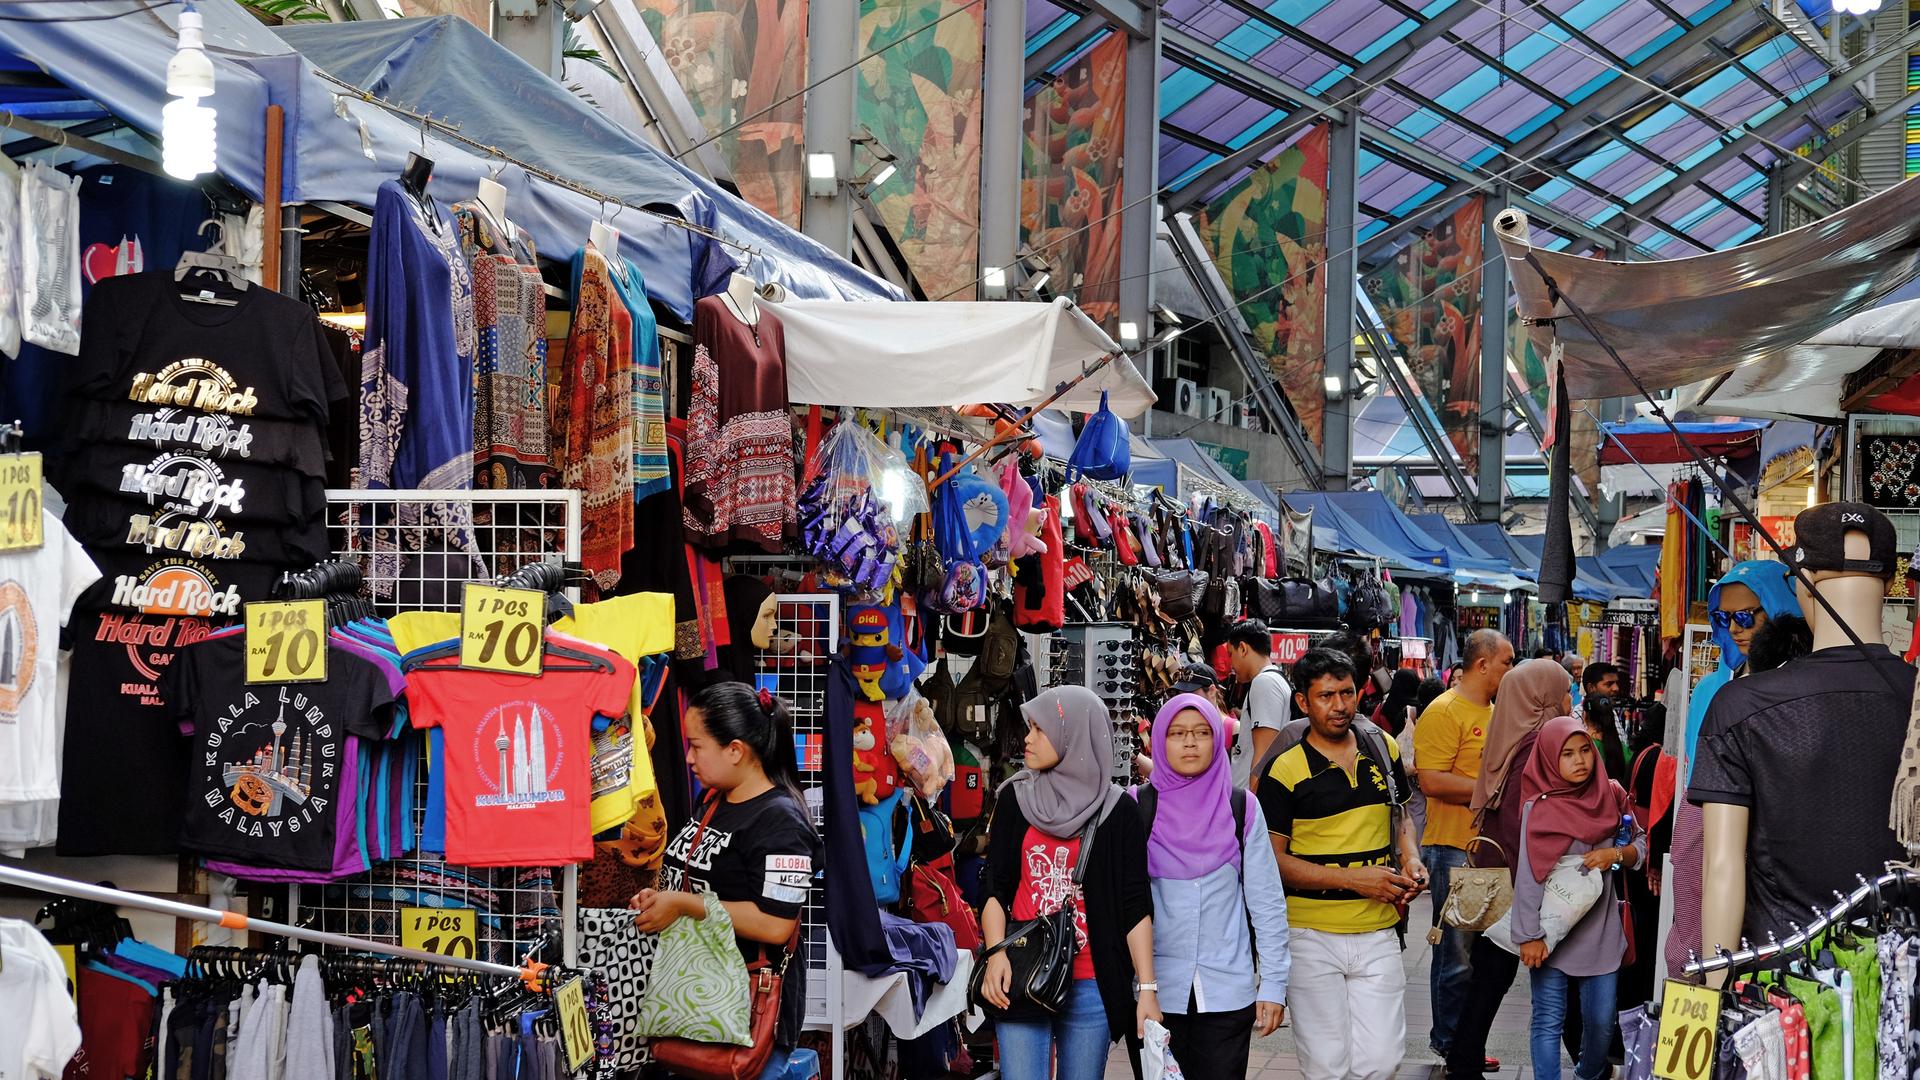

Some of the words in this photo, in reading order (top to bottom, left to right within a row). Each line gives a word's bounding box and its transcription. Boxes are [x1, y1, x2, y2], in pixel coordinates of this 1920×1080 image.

[157, 361, 181, 380] SAVE
[181, 358, 203, 366] THE
[128, 372, 198, 406] Hard
[193, 379, 258, 416] Rock
[128, 413, 196, 441] Hard
[192, 416, 253, 458] Rock
[147, 452, 171, 471] SAVE
[3, 468, 6, 485] 1
[10, 465, 30, 484] PCS
[120, 463, 188, 498] Hard
[181, 469, 245, 513] Rock
[8, 488, 38, 544] 10
[1841, 512, 1864, 523] EXO
[126, 514, 189, 550] Hard
[182, 522, 245, 559] Rock
[139, 562, 161, 581] SAVE
[163, 557, 184, 565] THE
[186, 559, 219, 586] PLANET
[1063, 574, 1079, 588] RM
[1069, 562, 1091, 582] 10
[111, 575, 178, 608] Hard
[178, 579, 241, 616] Rock
[259, 612, 266, 627] 1
[271, 609, 306, 627] PCS
[478, 598, 486, 612] 1
[492, 599, 528, 617] PCS
[95, 613, 175, 647] Hard
[174, 617, 228, 648] Ro
[858, 615, 878, 624] Didi
[262, 628, 318, 677] 10
[468, 631, 484, 640] RM
[478, 620, 538, 667] 10
[150, 654, 174, 665] CA
[206, 691, 260, 766] KUALA
[279, 686, 335, 778] LUMPUR
[476, 794, 513, 806] KUALA
[514, 789, 565, 804] LUMPUR
[205, 788, 328, 838] MALAYSIA
[775, 858, 810, 869] GLOBAL
[415, 917, 422, 931] 1
[428, 917, 461, 931] PCS
[564, 999, 567, 1011] 1
[568, 988, 579, 1007] PCS
[1672, 998, 1679, 1014] 1
[1681, 999, 1708, 1021] PCS
[570, 1006, 589, 1060] 10
[1662, 1036, 1673, 1046] RM
[1667, 1024, 1712, 1080] 10
